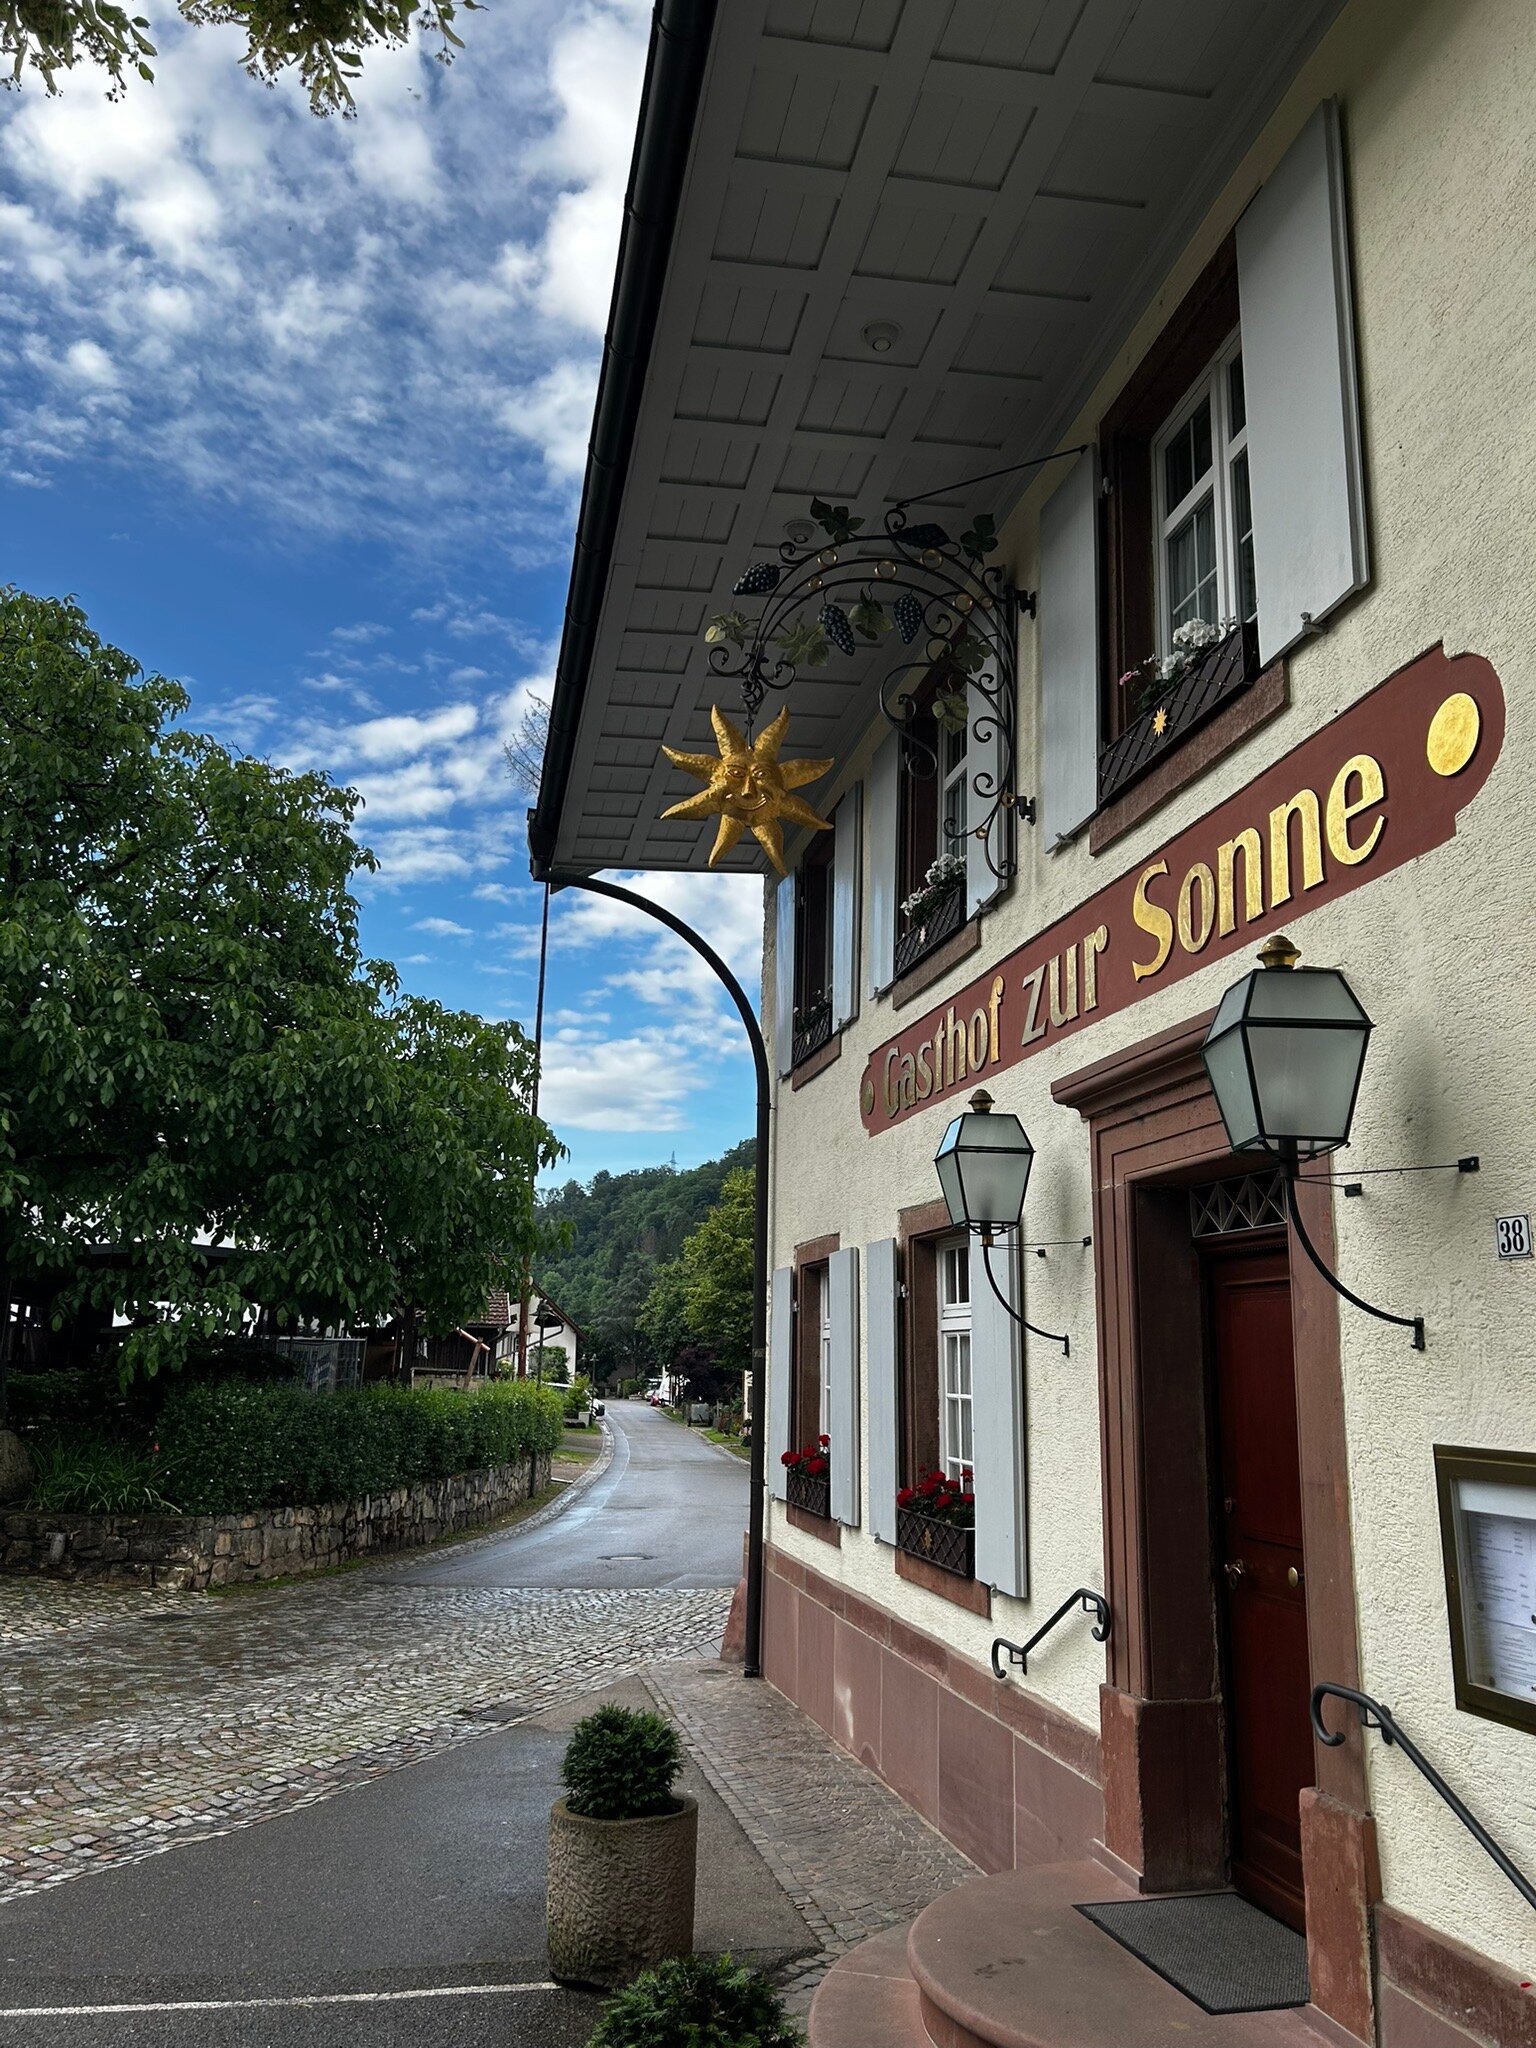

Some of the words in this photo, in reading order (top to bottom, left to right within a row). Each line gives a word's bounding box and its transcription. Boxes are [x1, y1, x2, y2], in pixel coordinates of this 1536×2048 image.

[884, 977, 1003, 1118] Gasthof
[1021, 925, 1108, 1046] zur
[1132, 755, 1385, 981] Sonne
[1500, 1219, 1524, 1253] 38
